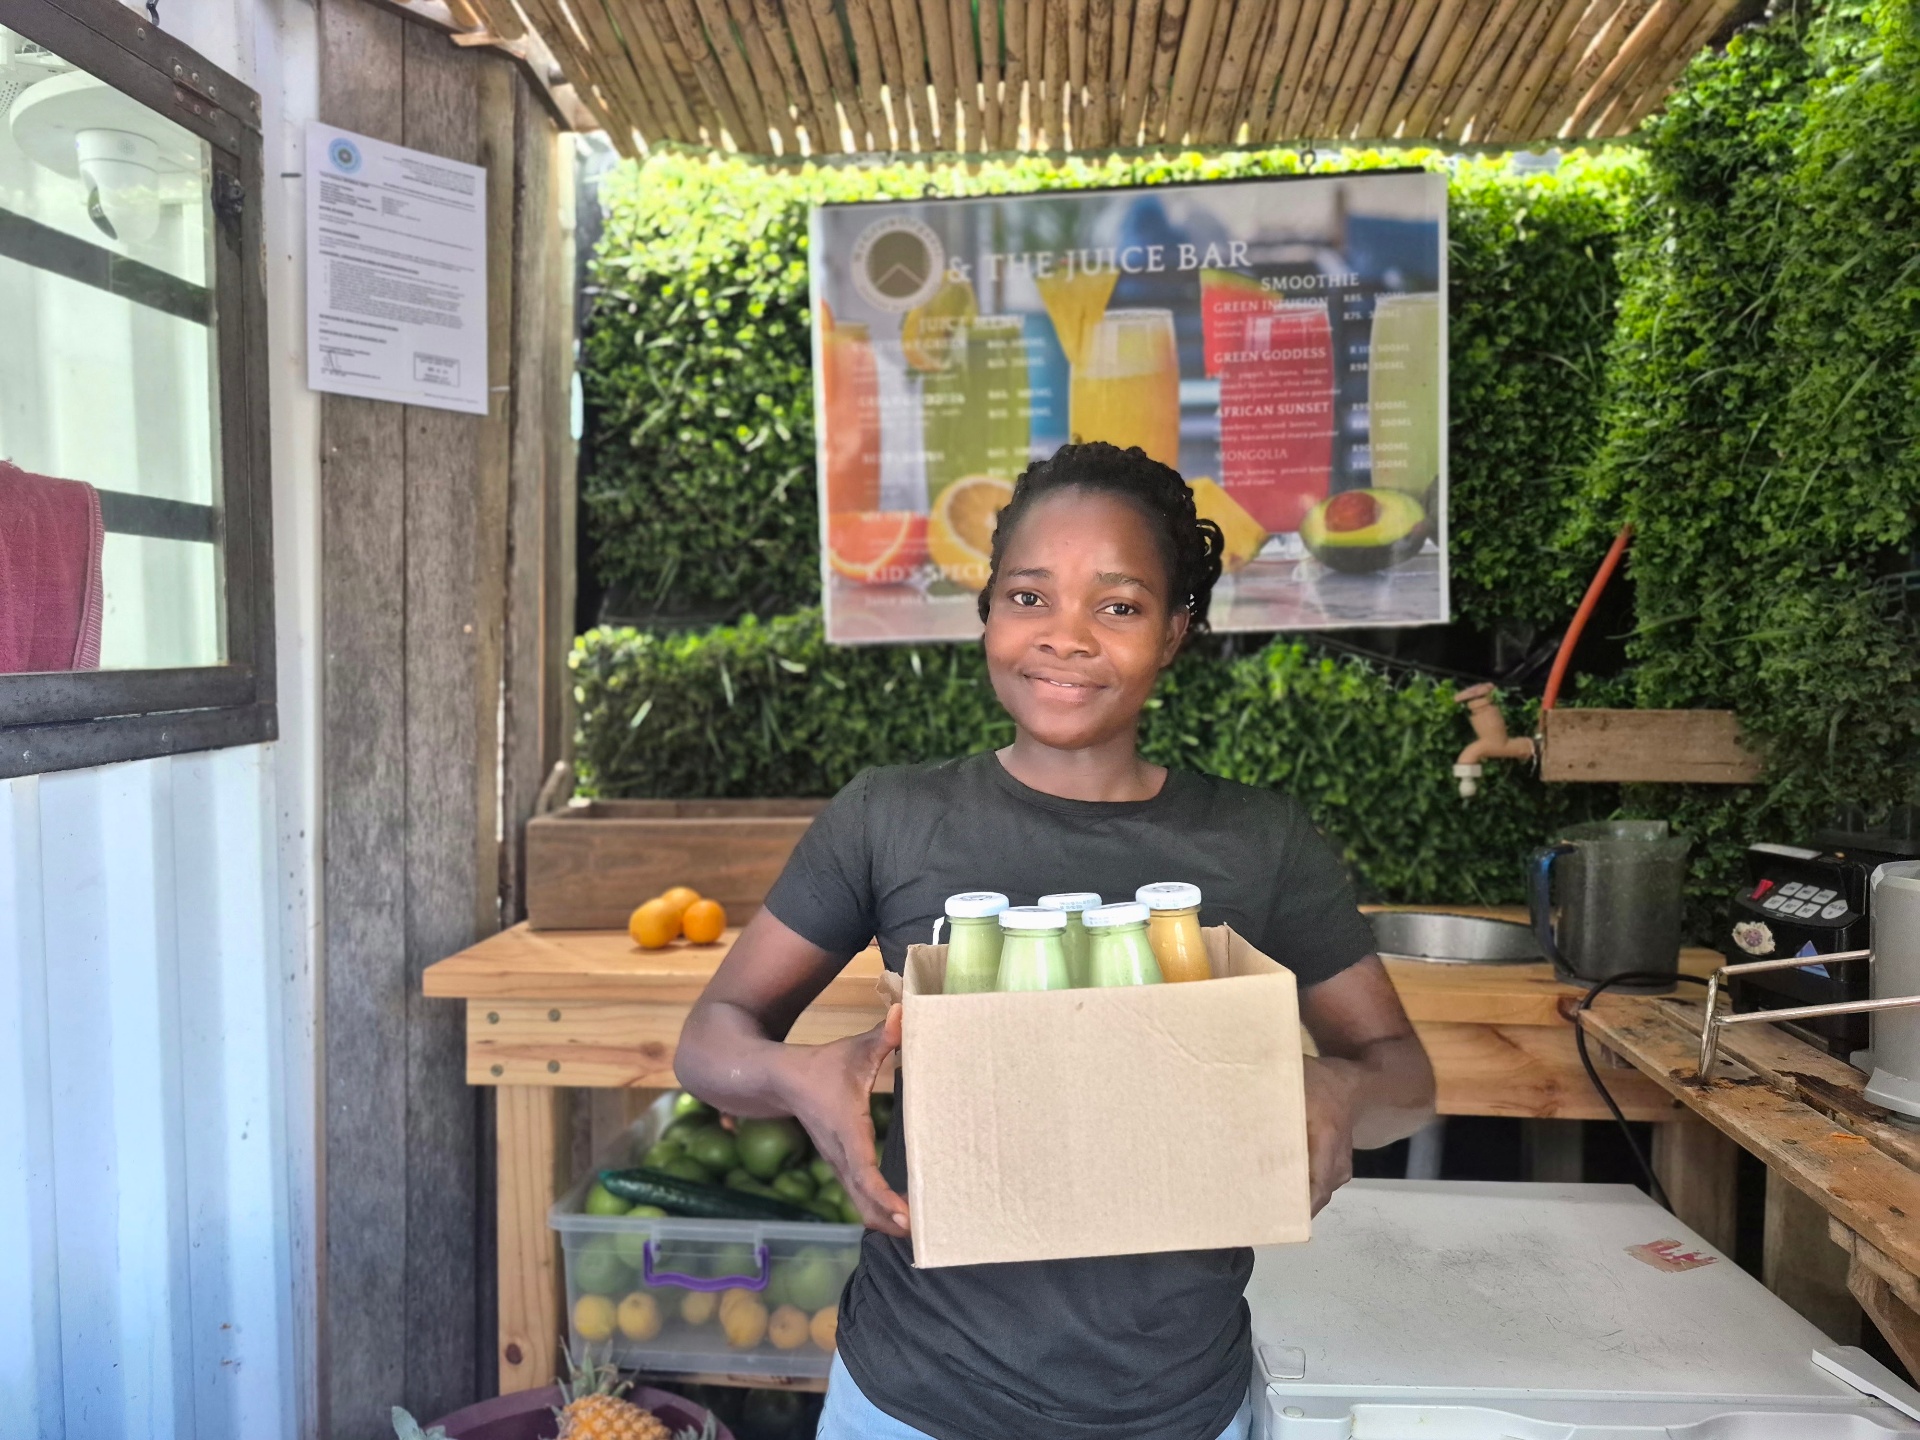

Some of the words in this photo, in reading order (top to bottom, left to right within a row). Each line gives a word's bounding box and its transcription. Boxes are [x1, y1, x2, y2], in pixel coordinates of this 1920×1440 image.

[949, 256, 973, 283] &
[983, 251, 1054, 281] THE
[1065, 244, 1164, 281] JUICE
[1177, 240, 1252, 270] BAR
[1261, 272, 1360, 292] SMOOTHIE
[1213, 300, 1258, 314] GREEN
[1262, 297, 1328, 311] INFUSION
[1213, 350, 1258, 364] GREEN
[1262, 347, 1326, 361] GODDESS
[1214, 404, 1273, 418] AFRICAN
[1277, 401, 1330, 416] SUNSET
